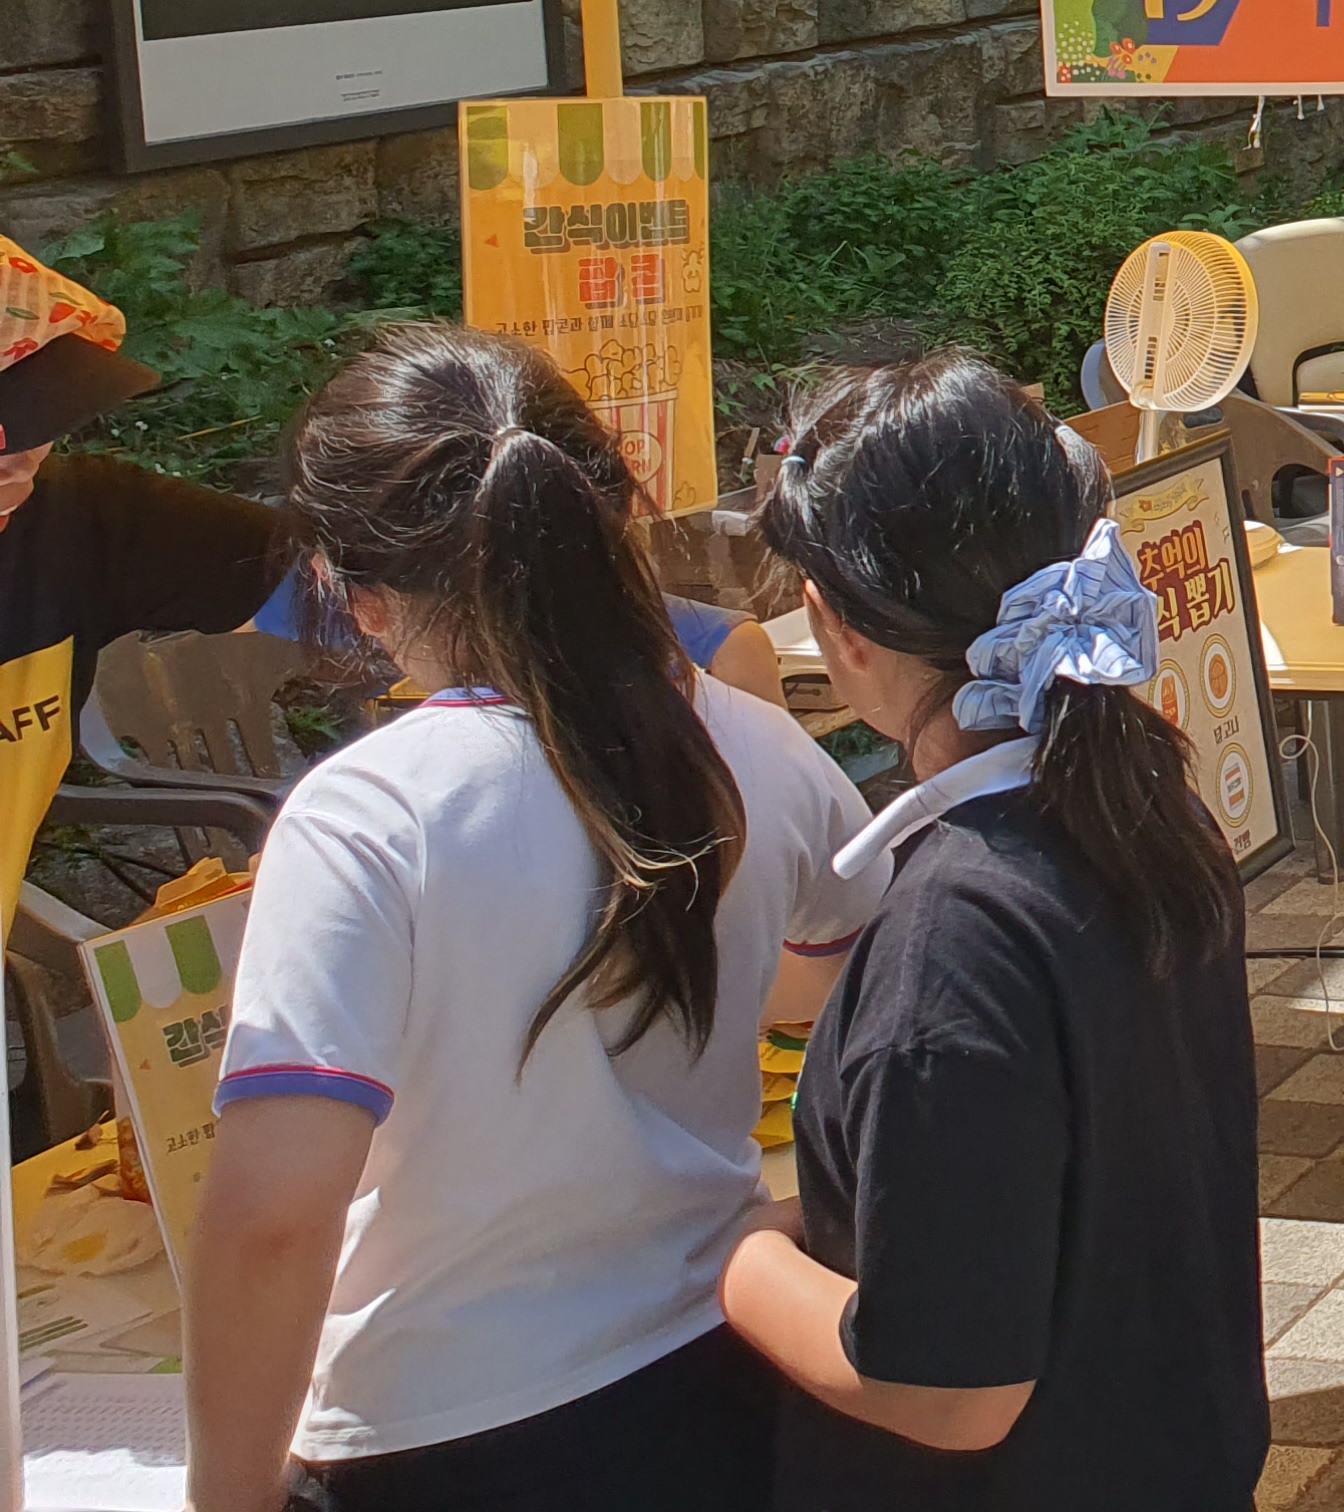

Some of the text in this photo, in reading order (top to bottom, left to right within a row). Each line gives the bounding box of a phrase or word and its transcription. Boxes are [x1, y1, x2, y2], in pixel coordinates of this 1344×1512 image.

[523, 199, 690, 255] 간식이벤트
[496, 320, 537, 337] 고소한
[1137, 519, 1209, 591] 추억의
[1184, 558, 1236, 633] 뽑기
[166, 1129, 199, 1153] 고소한
